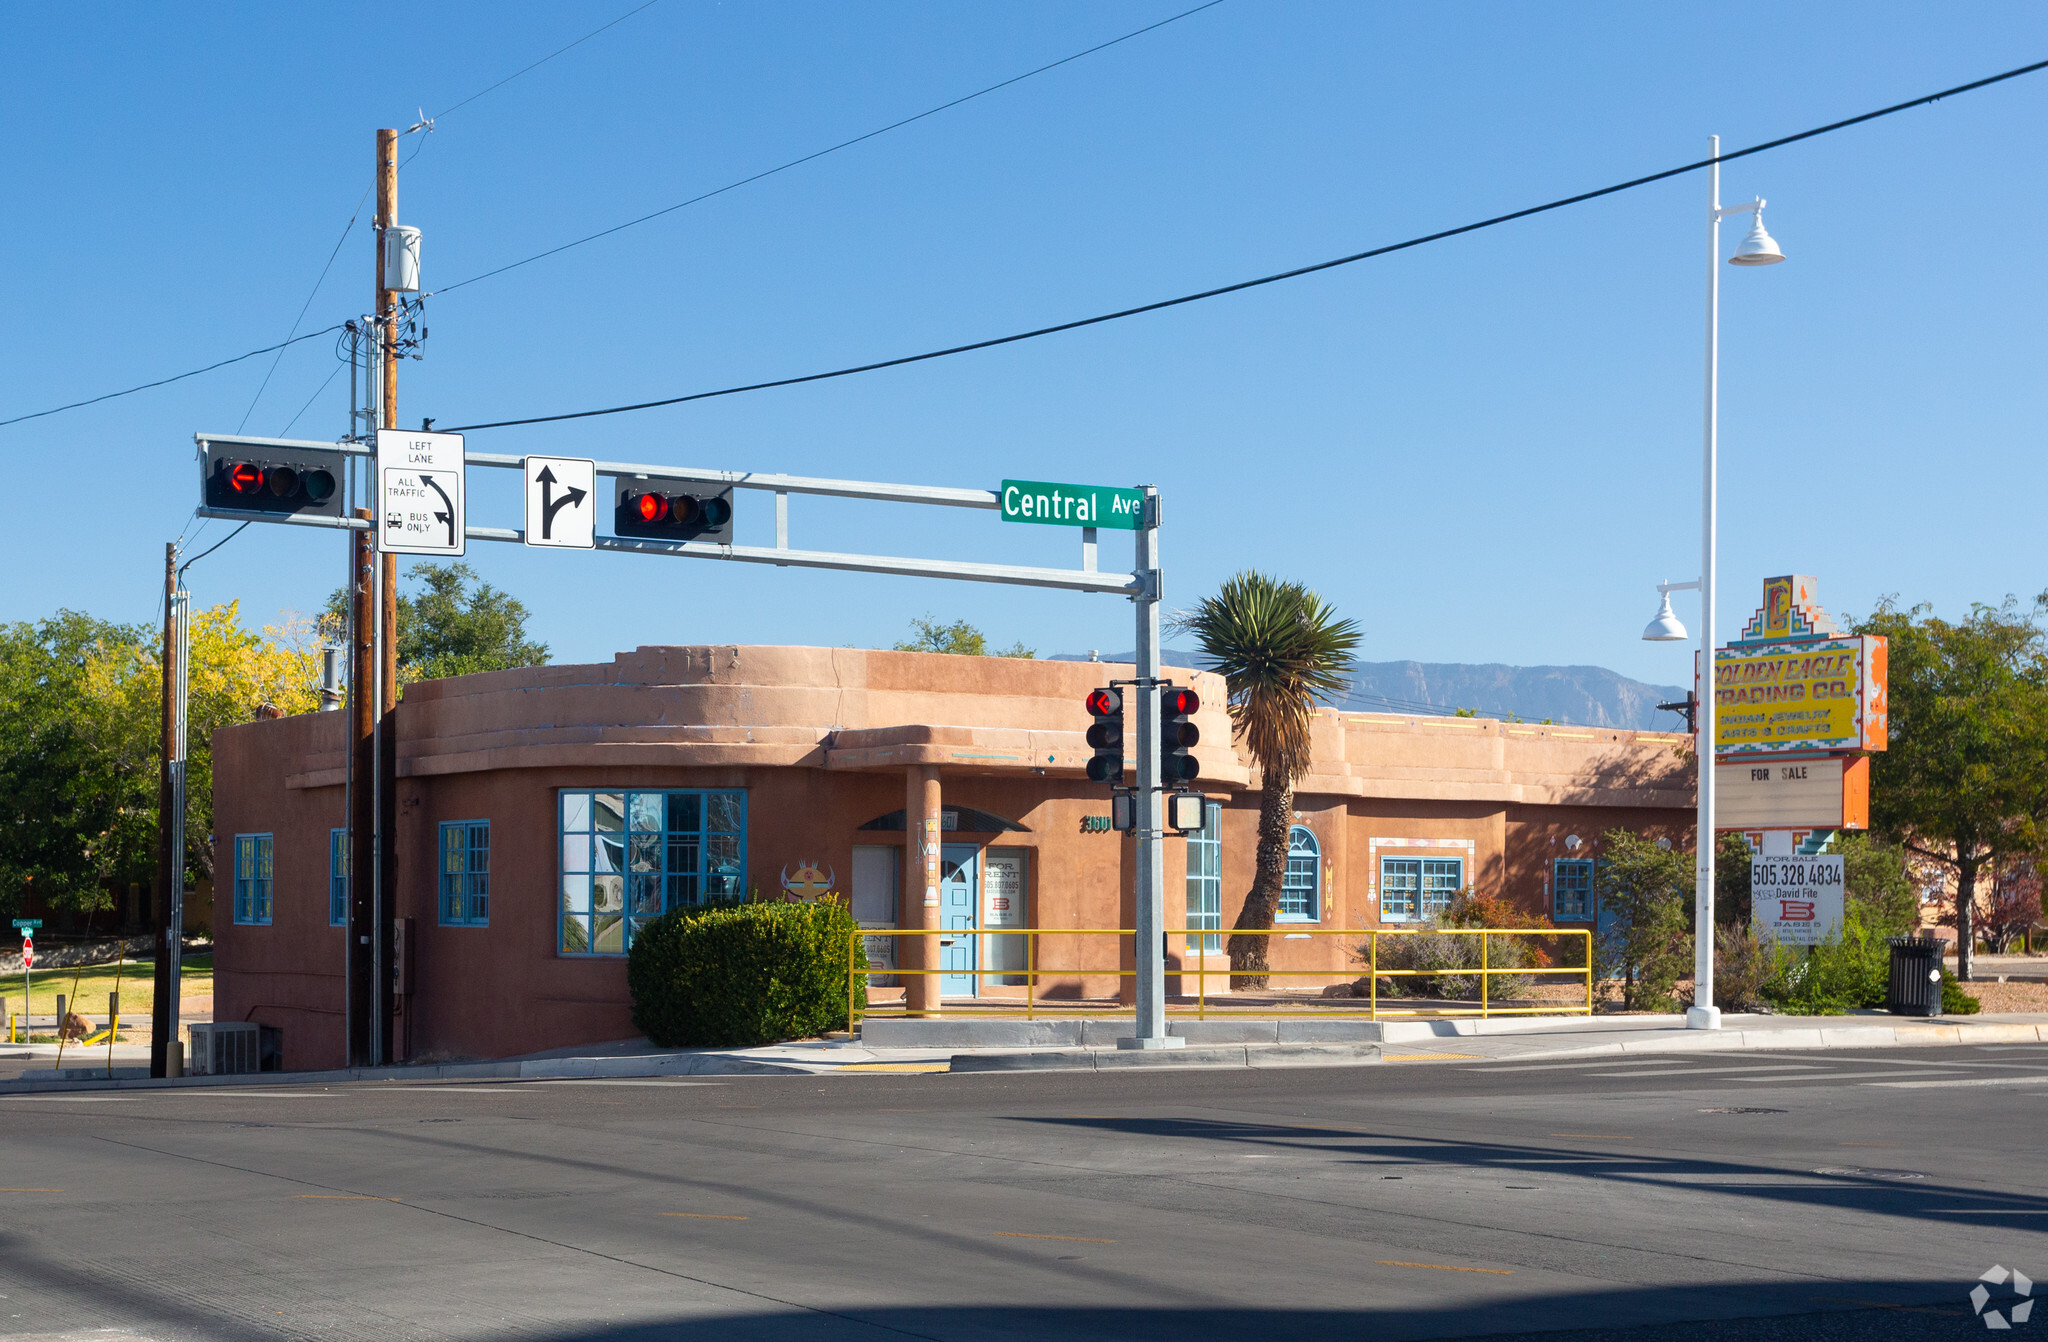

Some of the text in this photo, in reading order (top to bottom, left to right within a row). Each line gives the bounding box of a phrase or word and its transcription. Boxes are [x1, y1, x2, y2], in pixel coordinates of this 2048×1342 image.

[409, 441, 432, 451] LEFT
[408, 454, 434, 464] LANE
[398, 478, 415, 487] ALL
[388, 488, 425, 498] TRAFFIC
[1004, 486, 1141, 521] Central Ave
[410, 513, 428, 522] BUS
[407, 523, 431, 534] ONLY
[1782, 654, 1850, 681] EAGLE
[1722, 727, 1757, 738] ARTS
[1776, 724, 1831, 735] CRAFTS
[1751, 766, 1808, 781] FOR SALE
[1753, 864, 1841, 886] 505.328.4834
[1776, 888, 1800, 899] David
[1802, 888, 1818, 899] Fite
[13, 919, 32, 927] Copper
